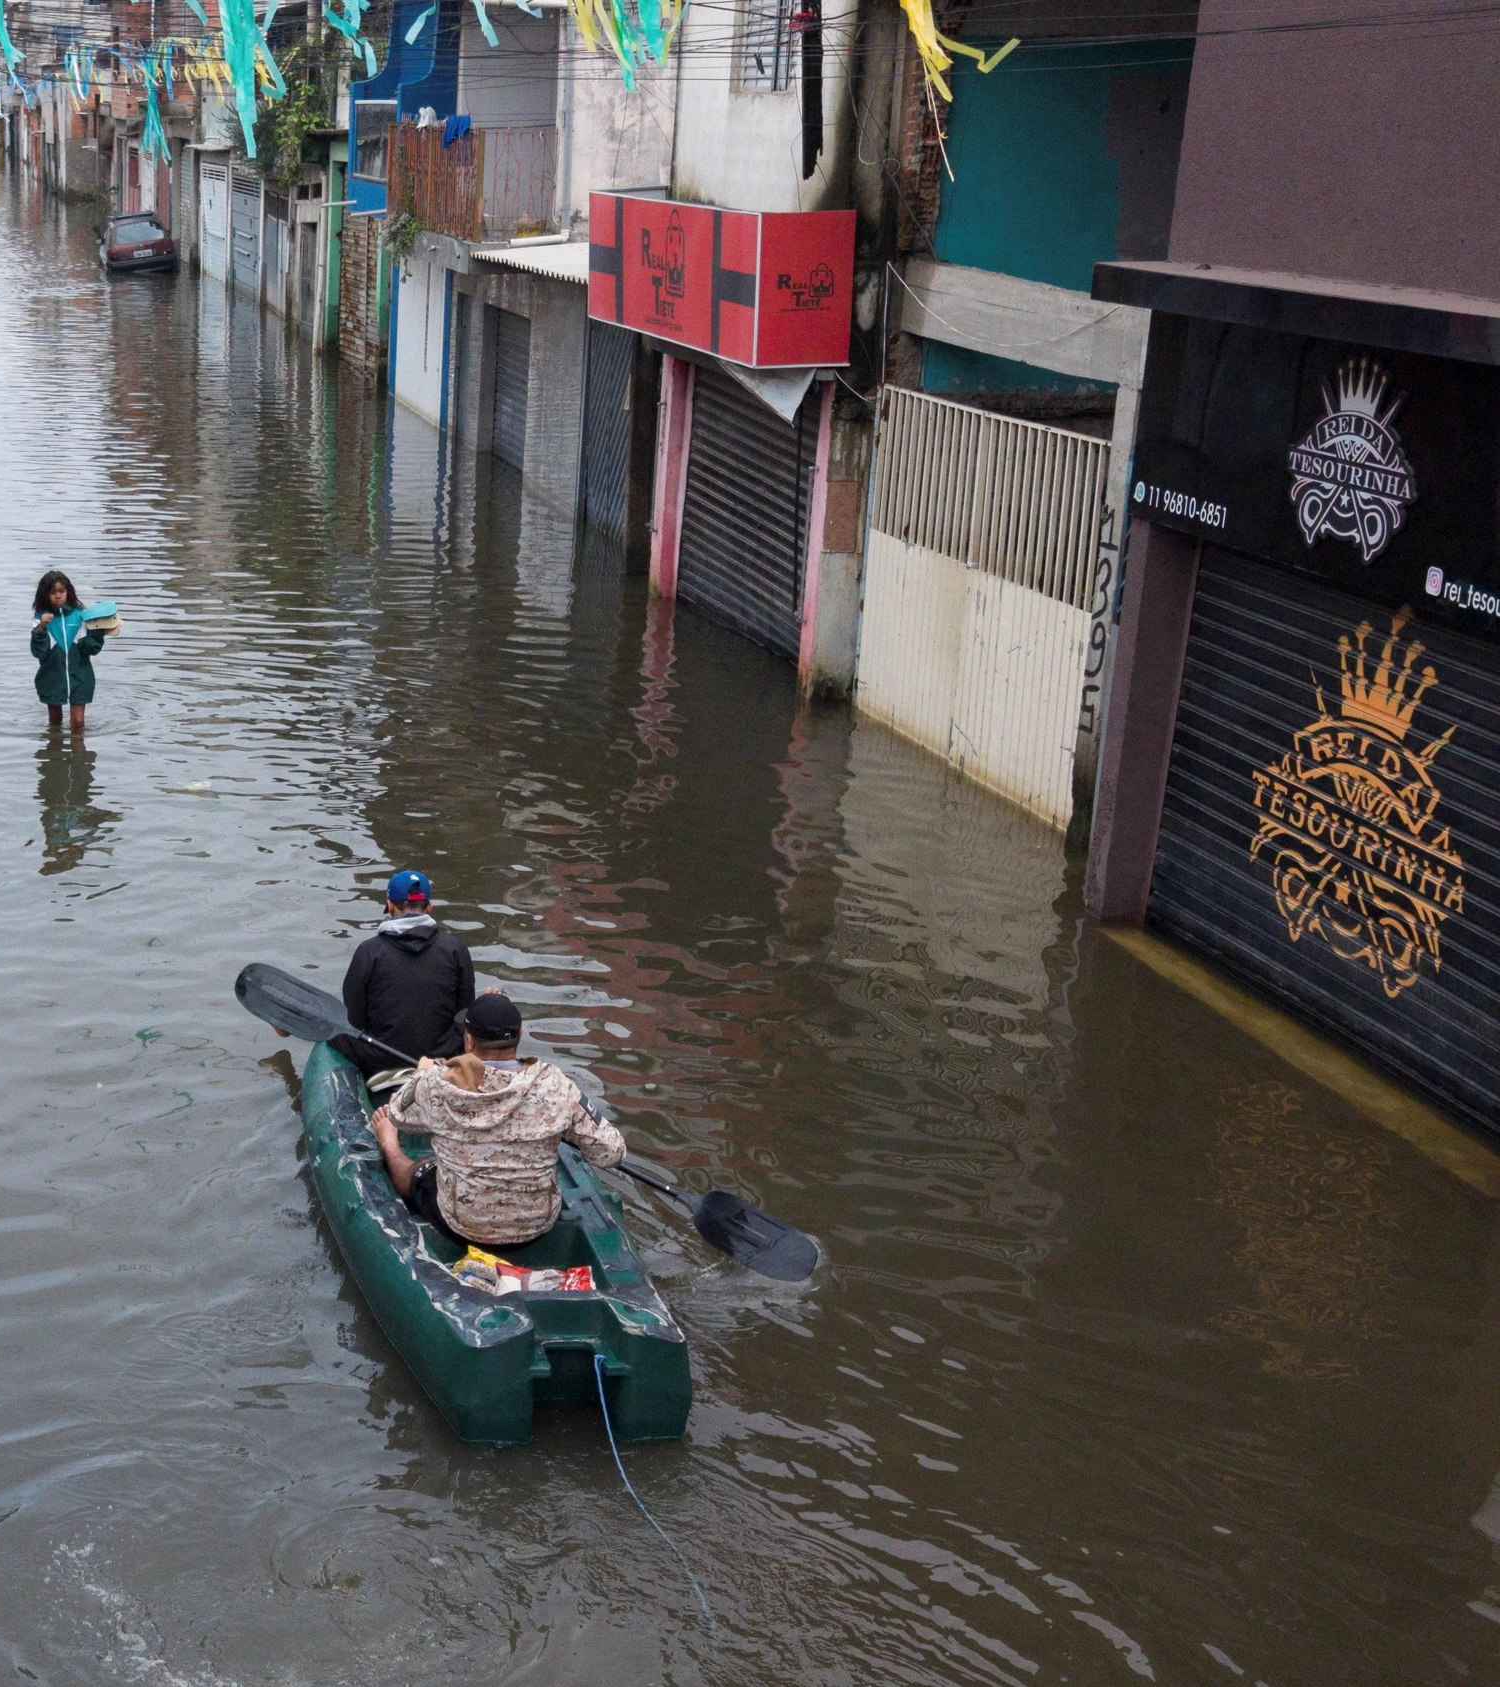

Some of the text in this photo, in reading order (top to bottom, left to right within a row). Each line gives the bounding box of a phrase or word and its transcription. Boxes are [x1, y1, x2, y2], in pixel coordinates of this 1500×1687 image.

[641, 228, 666, 271] REAL
[777, 273, 809, 290] REAL
[1322, 416, 1384, 452] REI DA
[1288, 451, 1412, 500] TESOURINHA
[1149, 485, 1227, 529] 11 96810-6851
[1311, 733, 1422, 816] REI DA
[1251, 770, 1465, 915] TESOURINHA
